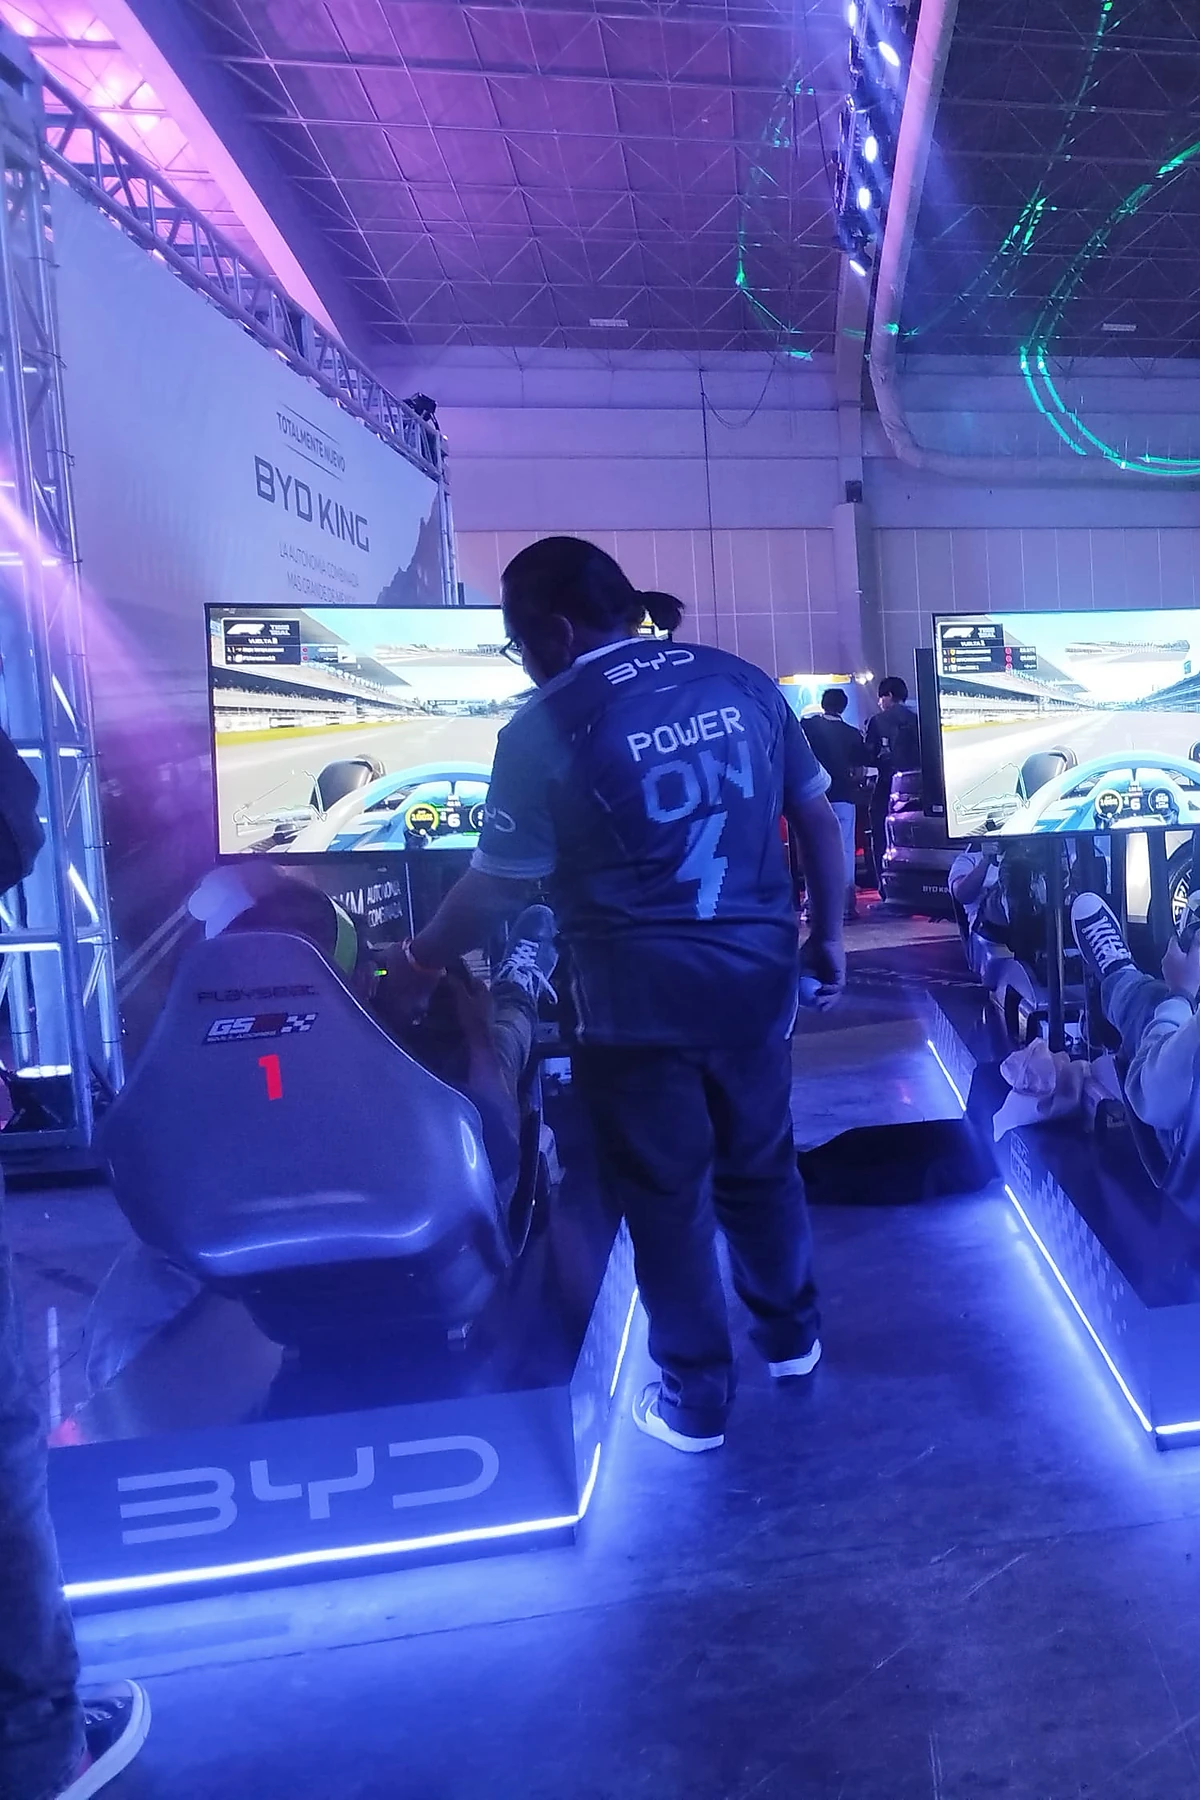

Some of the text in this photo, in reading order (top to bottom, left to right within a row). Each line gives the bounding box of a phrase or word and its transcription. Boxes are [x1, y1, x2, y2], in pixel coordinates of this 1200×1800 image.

[276, 411, 346, 473] TOTALMENTE NUEVO
[254, 454, 370, 553] BYD KING
[603, 649, 695, 685] BYD
[626, 706, 745, 762] POWER
[641, 741, 755, 824] ON
[208, 1017, 256, 1036] GS
[258, 1054, 283, 1101] 1
[117, 1435, 500, 1545] BYD
